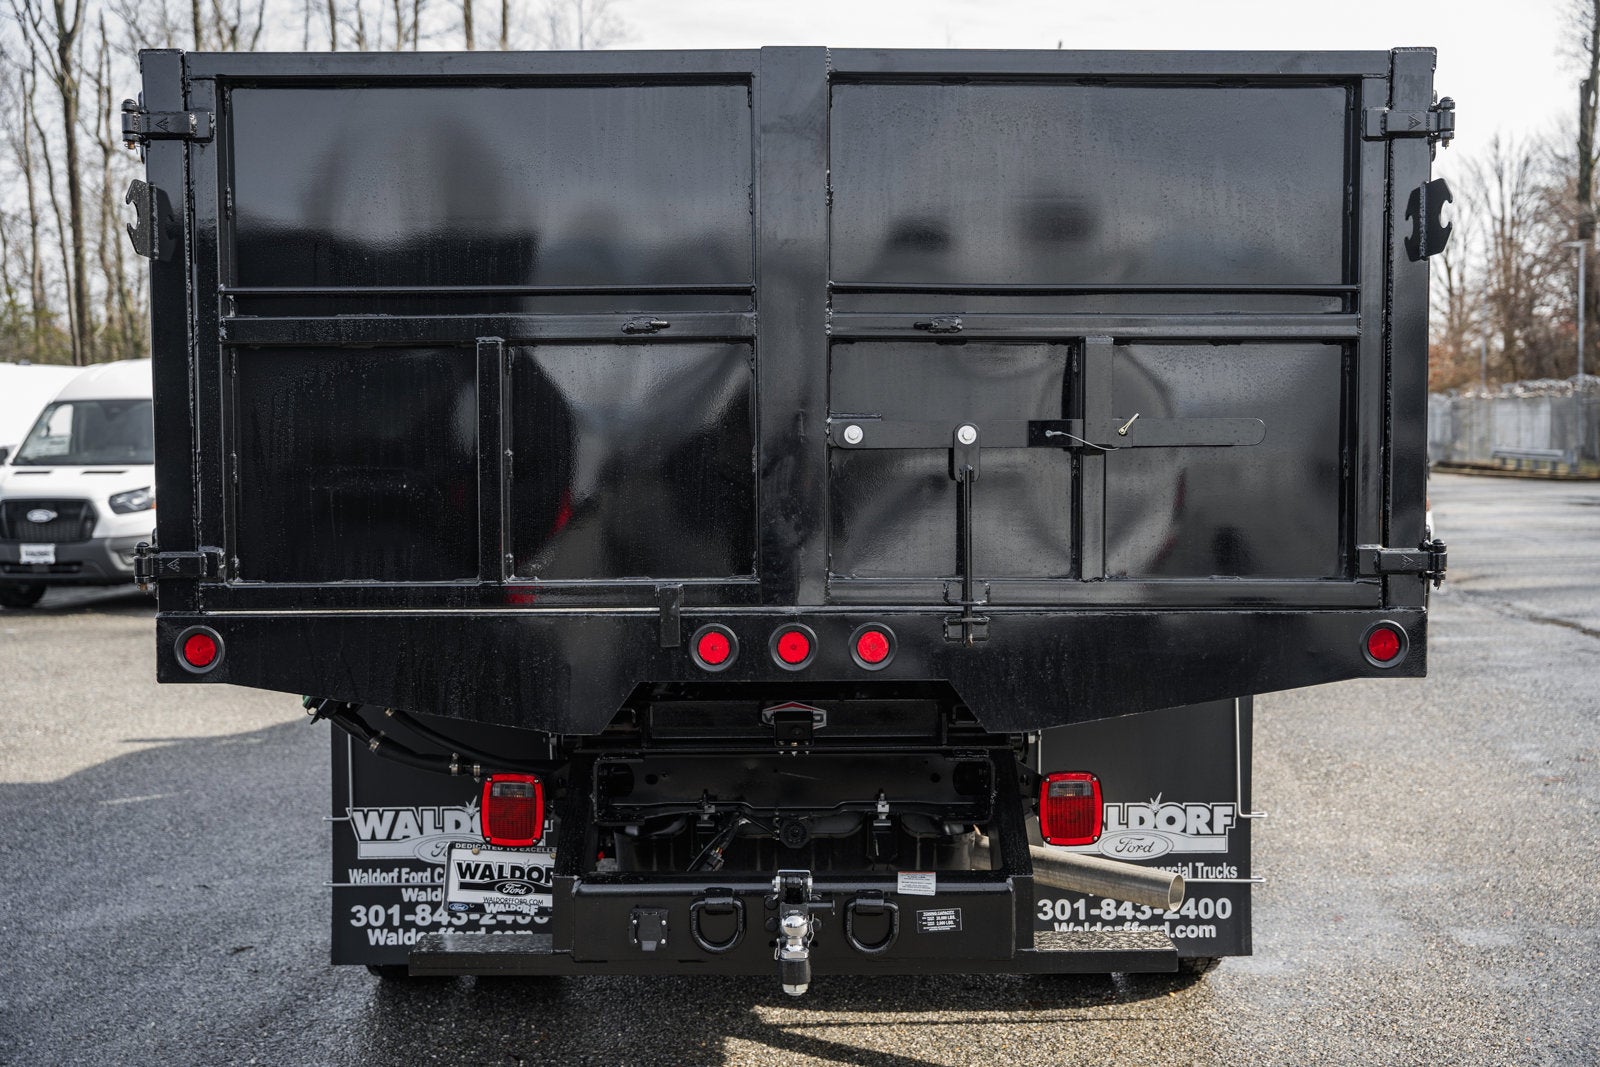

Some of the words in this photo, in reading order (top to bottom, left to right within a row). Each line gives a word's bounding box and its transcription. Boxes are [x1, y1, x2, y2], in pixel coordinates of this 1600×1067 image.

[350, 807, 482, 842] WALD
[1104, 804, 1235, 836] LDORF
[455, 842, 504, 852] DEDICATED
[1115, 837, 1155, 854] Ford
[349, 868, 400, 884] Waldorf
[401, 868, 432, 884] Ford
[455, 861, 554, 885] WALDOR
[1195, 862, 1238, 879] Trucks
[402, 888, 443, 903] Wald
[502, 883, 527, 896] Ford
[484, 902, 540, 916] WALDORF
